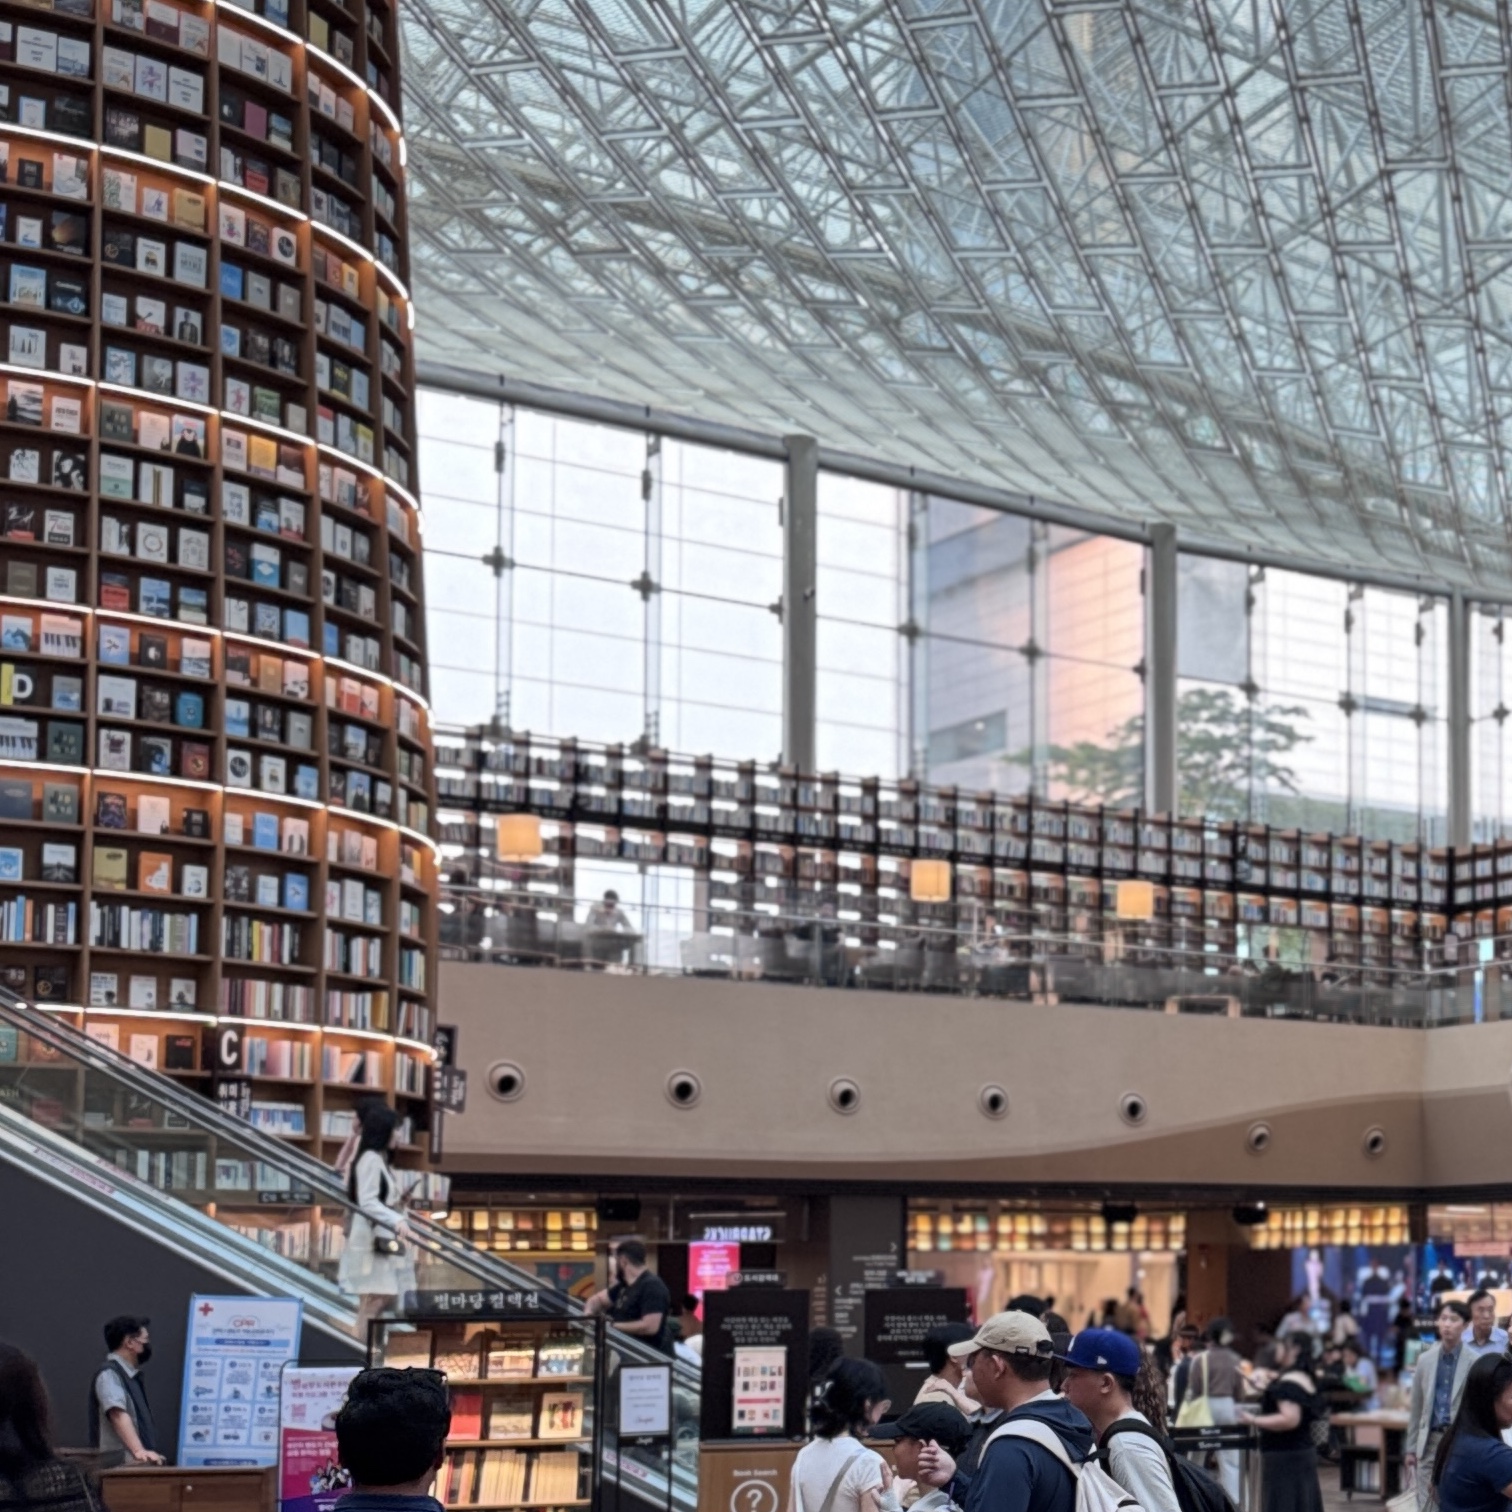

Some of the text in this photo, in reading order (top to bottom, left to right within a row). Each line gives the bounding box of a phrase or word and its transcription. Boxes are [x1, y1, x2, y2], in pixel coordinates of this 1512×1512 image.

[221, 1030, 238, 1066] C
[434, 1292, 540, 1310] 별마당 컬렉션
